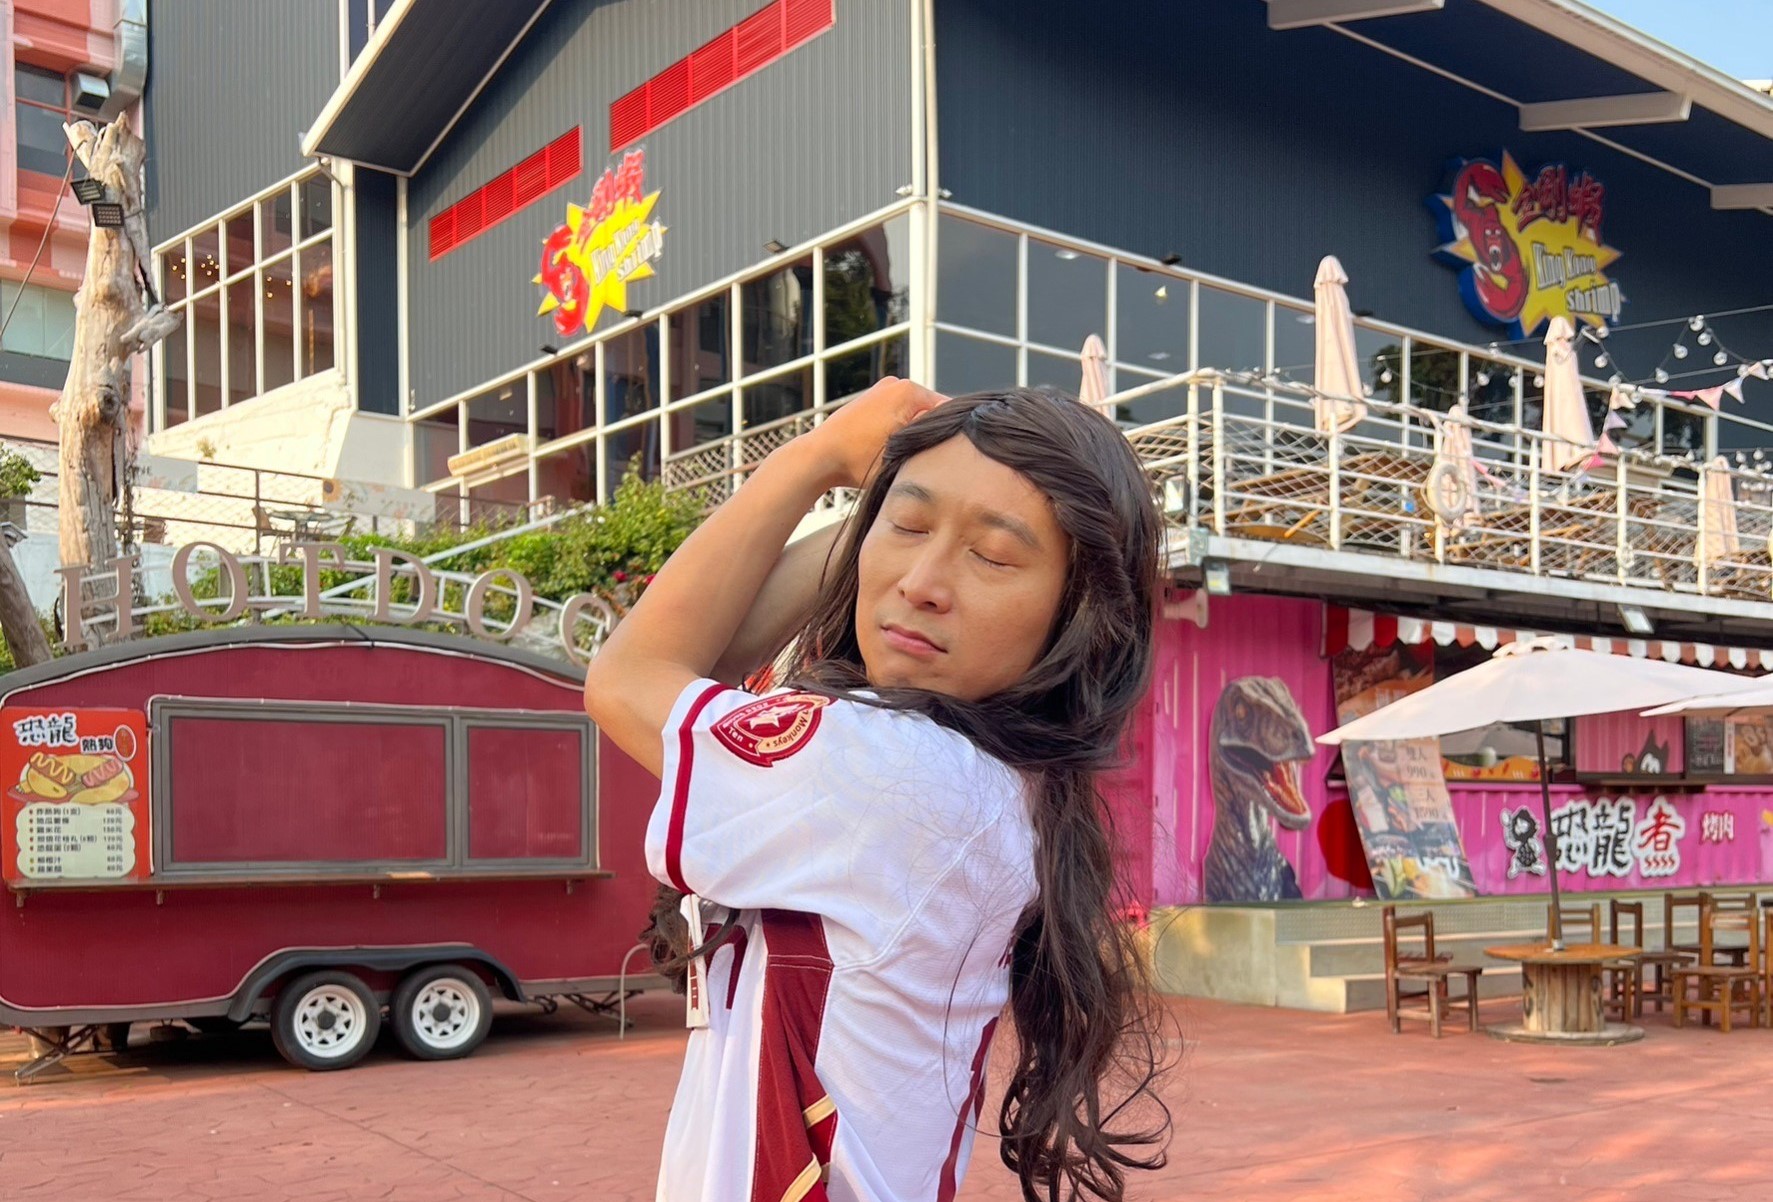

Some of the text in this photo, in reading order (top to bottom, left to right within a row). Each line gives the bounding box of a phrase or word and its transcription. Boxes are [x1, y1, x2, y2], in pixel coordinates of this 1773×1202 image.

[1531, 242, 1566, 289] King
[1565, 280, 1621, 322] shrimp
[16, 716, 76, 744] 恐龍
[82, 737, 114, 752] 熱狗
[773, 716, 809, 748] Monkeys
[1702, 812, 1734, 842] 烤肉
